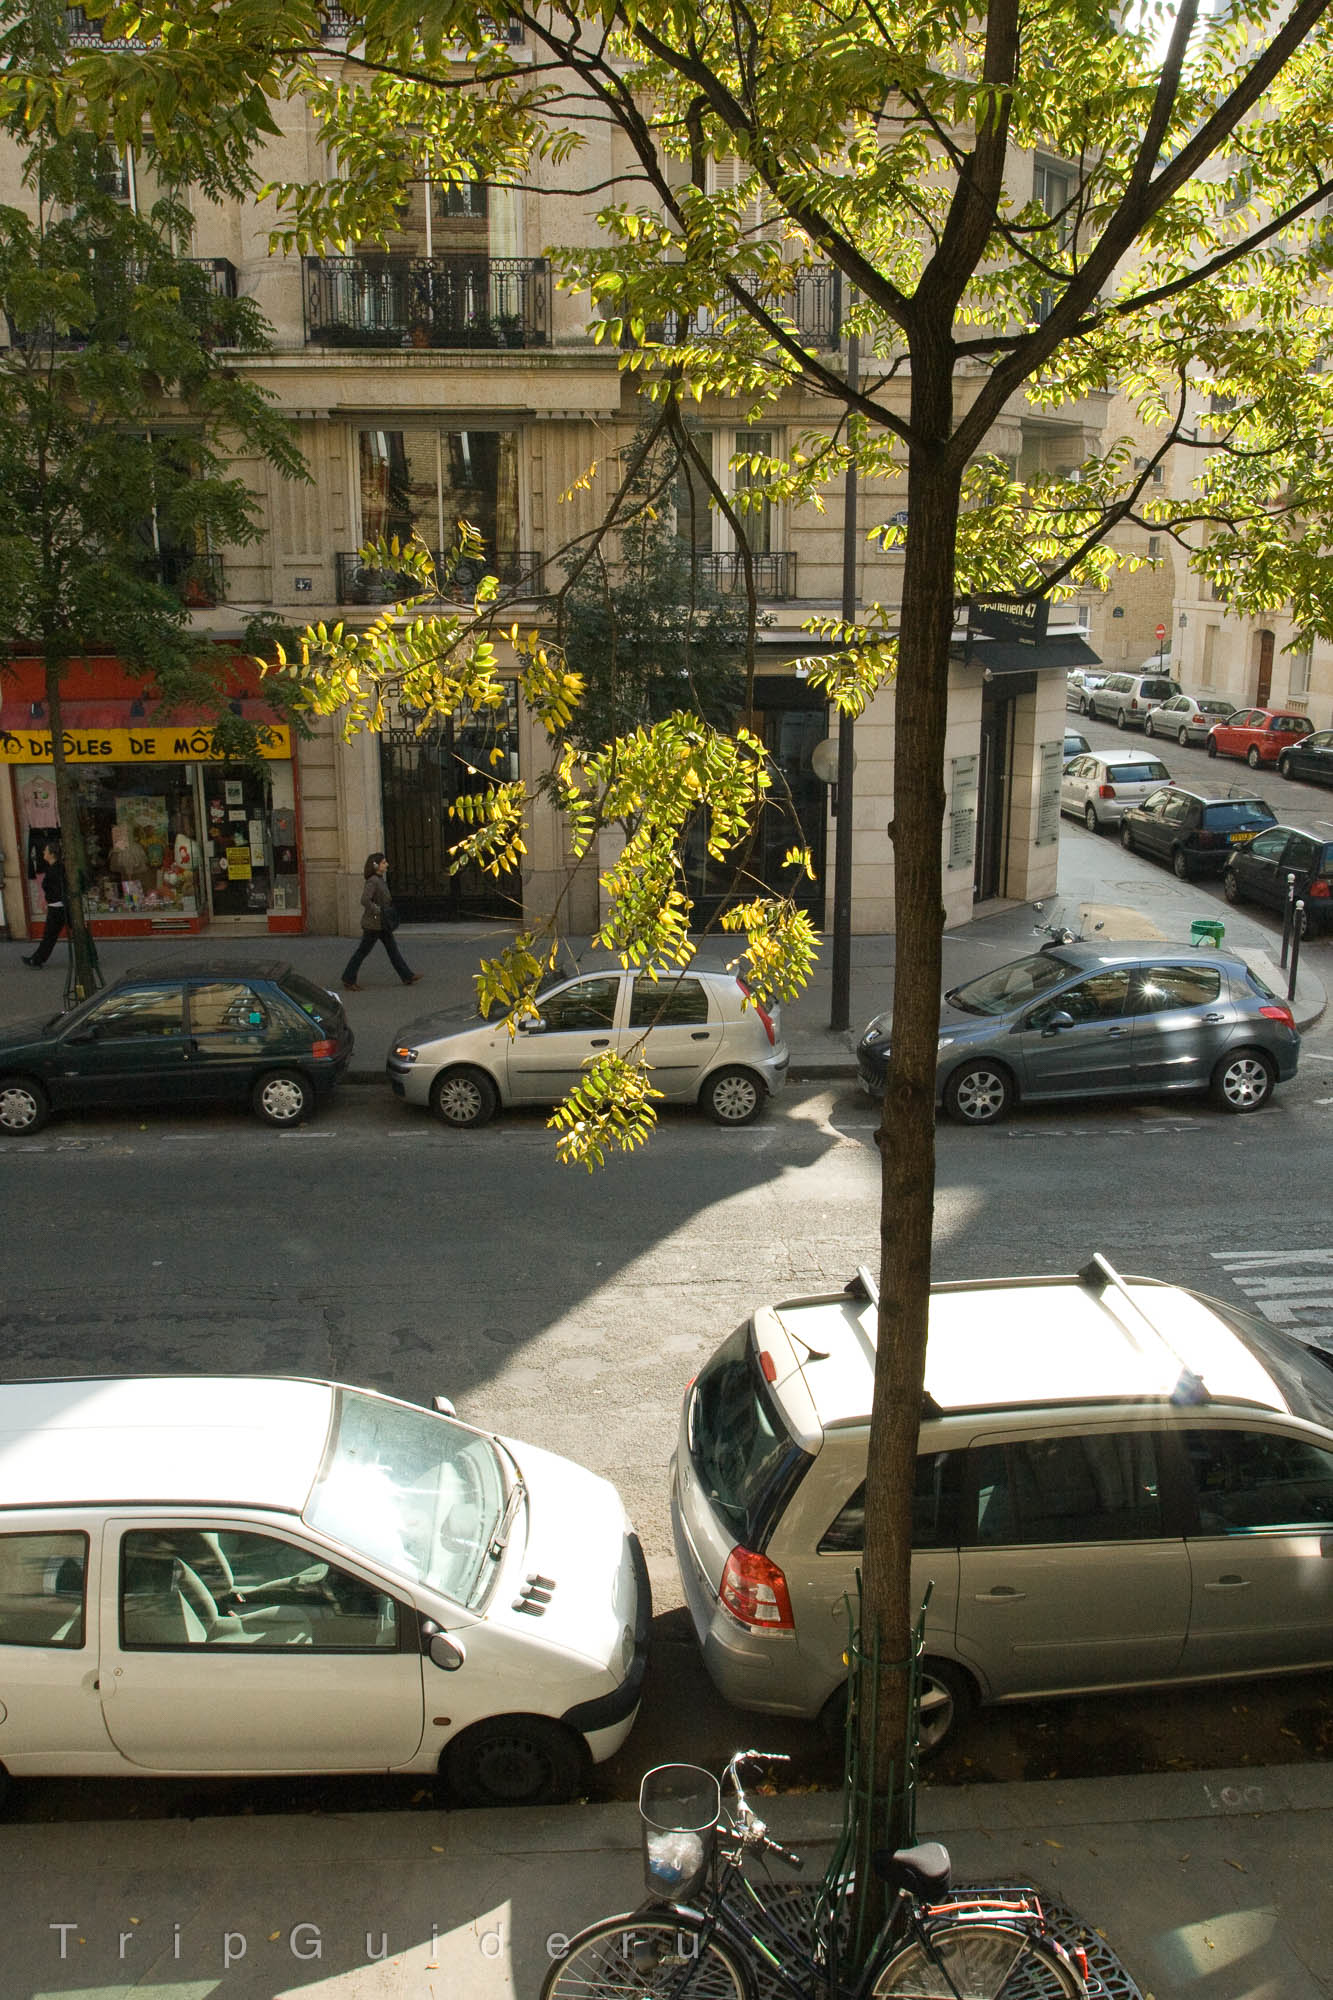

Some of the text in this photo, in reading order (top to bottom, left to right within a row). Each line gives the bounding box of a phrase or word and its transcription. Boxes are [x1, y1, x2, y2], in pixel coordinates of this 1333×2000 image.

[976, 602, 1037, 618] ppartement 47
[128, 737, 156, 755] DE
